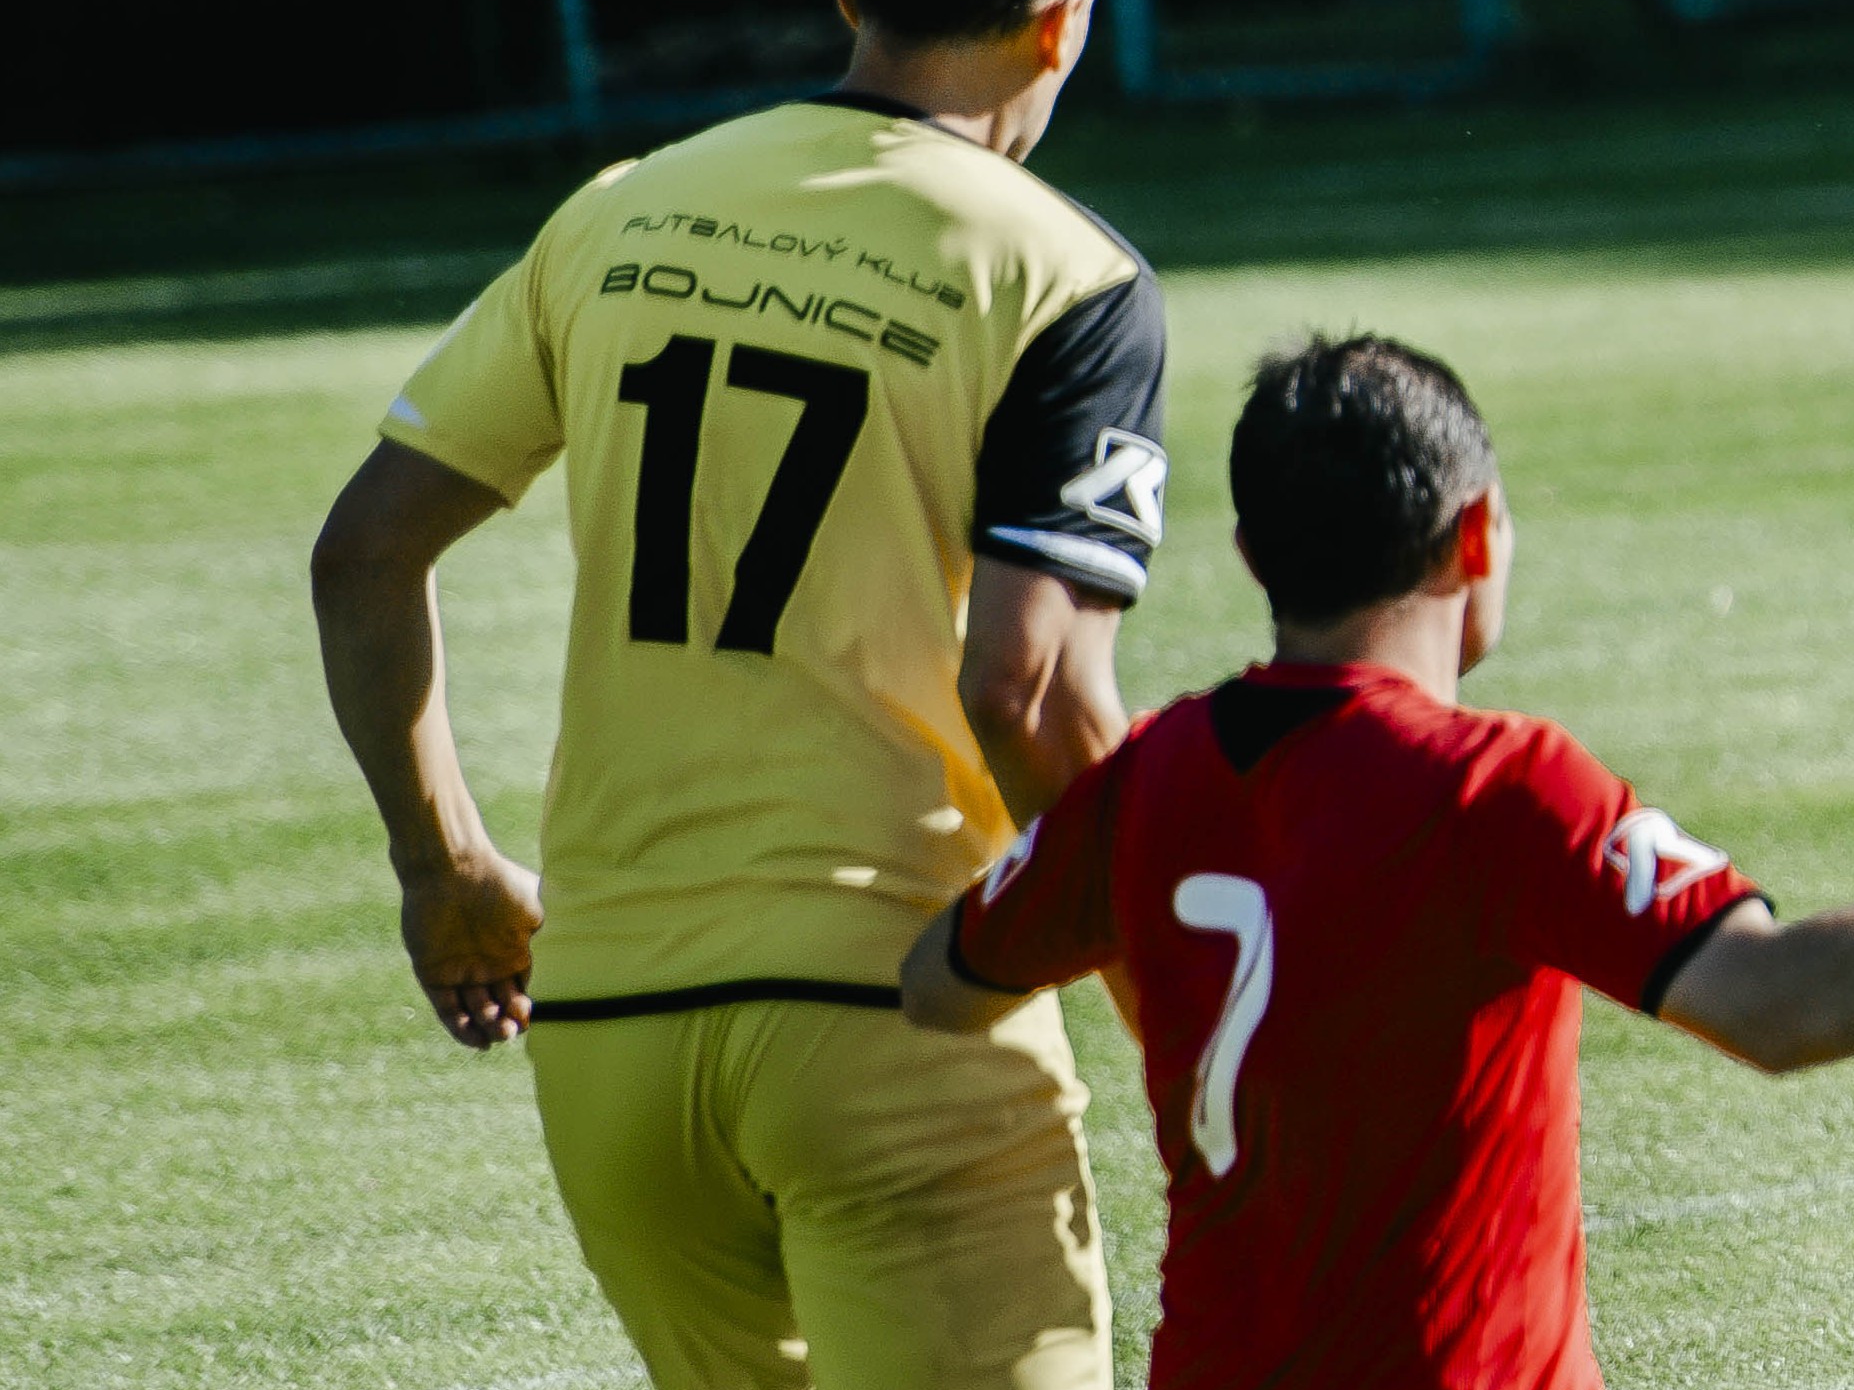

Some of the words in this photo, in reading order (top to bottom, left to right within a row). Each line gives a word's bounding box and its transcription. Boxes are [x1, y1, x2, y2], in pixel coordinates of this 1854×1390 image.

[600, 263, 940, 369] BOJNICE
[621, 211, 849, 260] FUTBALOVÝ
[855, 252, 966, 310] KLUB
[618, 333, 870, 655] 17
[1172, 873, 1274, 1177] 7
